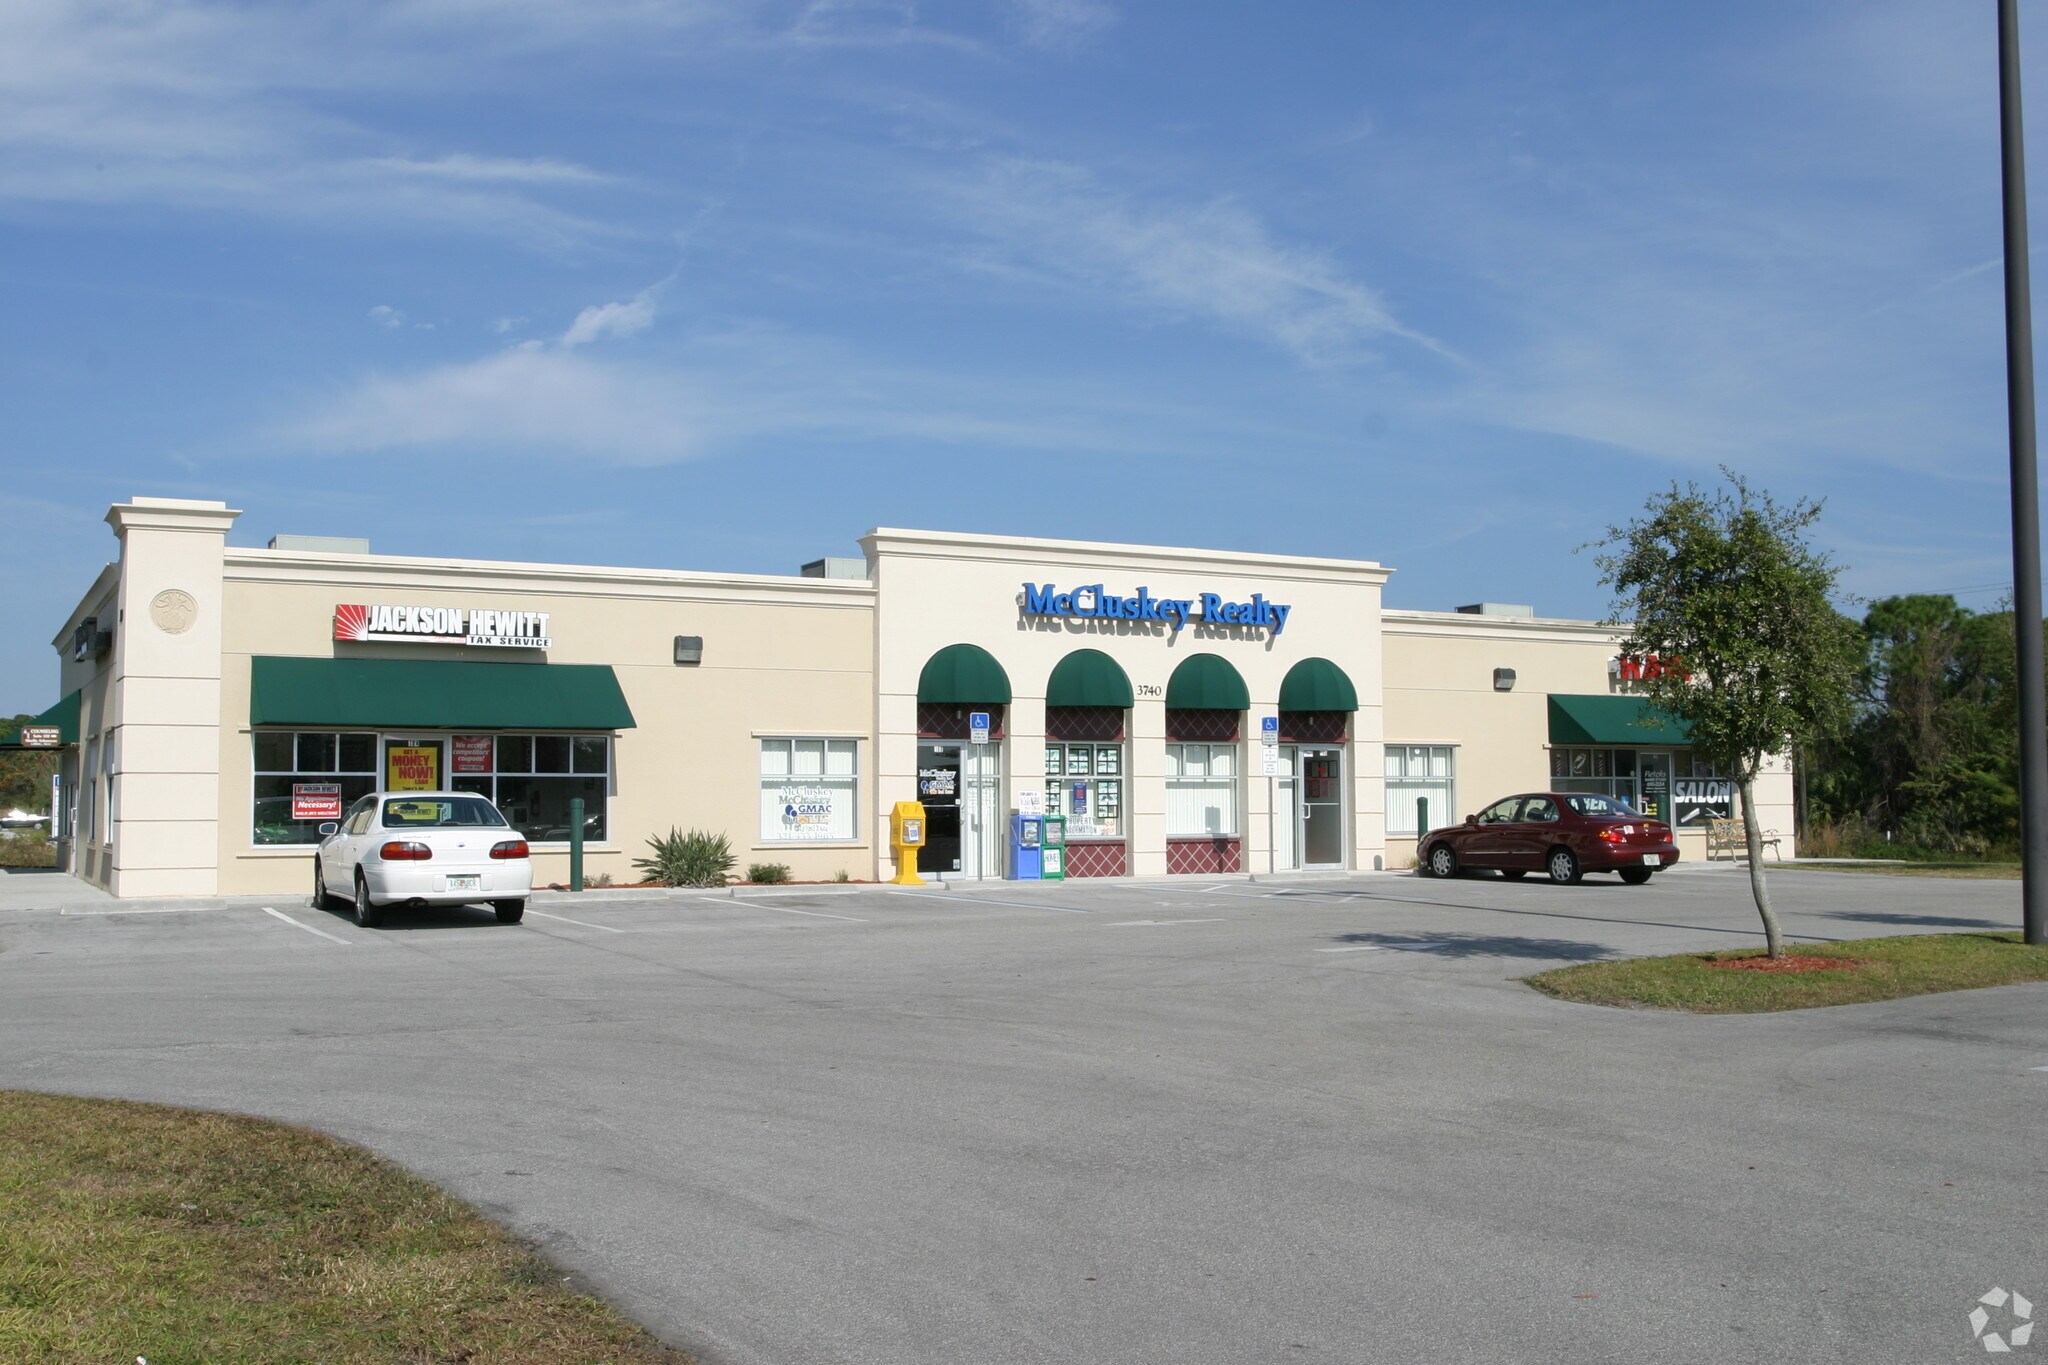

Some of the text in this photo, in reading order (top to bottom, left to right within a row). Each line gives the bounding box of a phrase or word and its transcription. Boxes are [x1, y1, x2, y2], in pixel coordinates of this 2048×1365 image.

[1022, 582, 1292, 635] McCluskey Realty
[368, 605, 550, 637] JACKSON HEWITT
[469, 636, 550, 647] TAX SERVICE
[1136, 684, 1162, 697] 3740
[391, 755, 430, 767] MONEY
[398, 767, 434, 779] NOW!
[1675, 781, 1731, 804] SALON
[297, 801, 337, 810] Necessary!
[798, 804, 832, 814] GMAC
